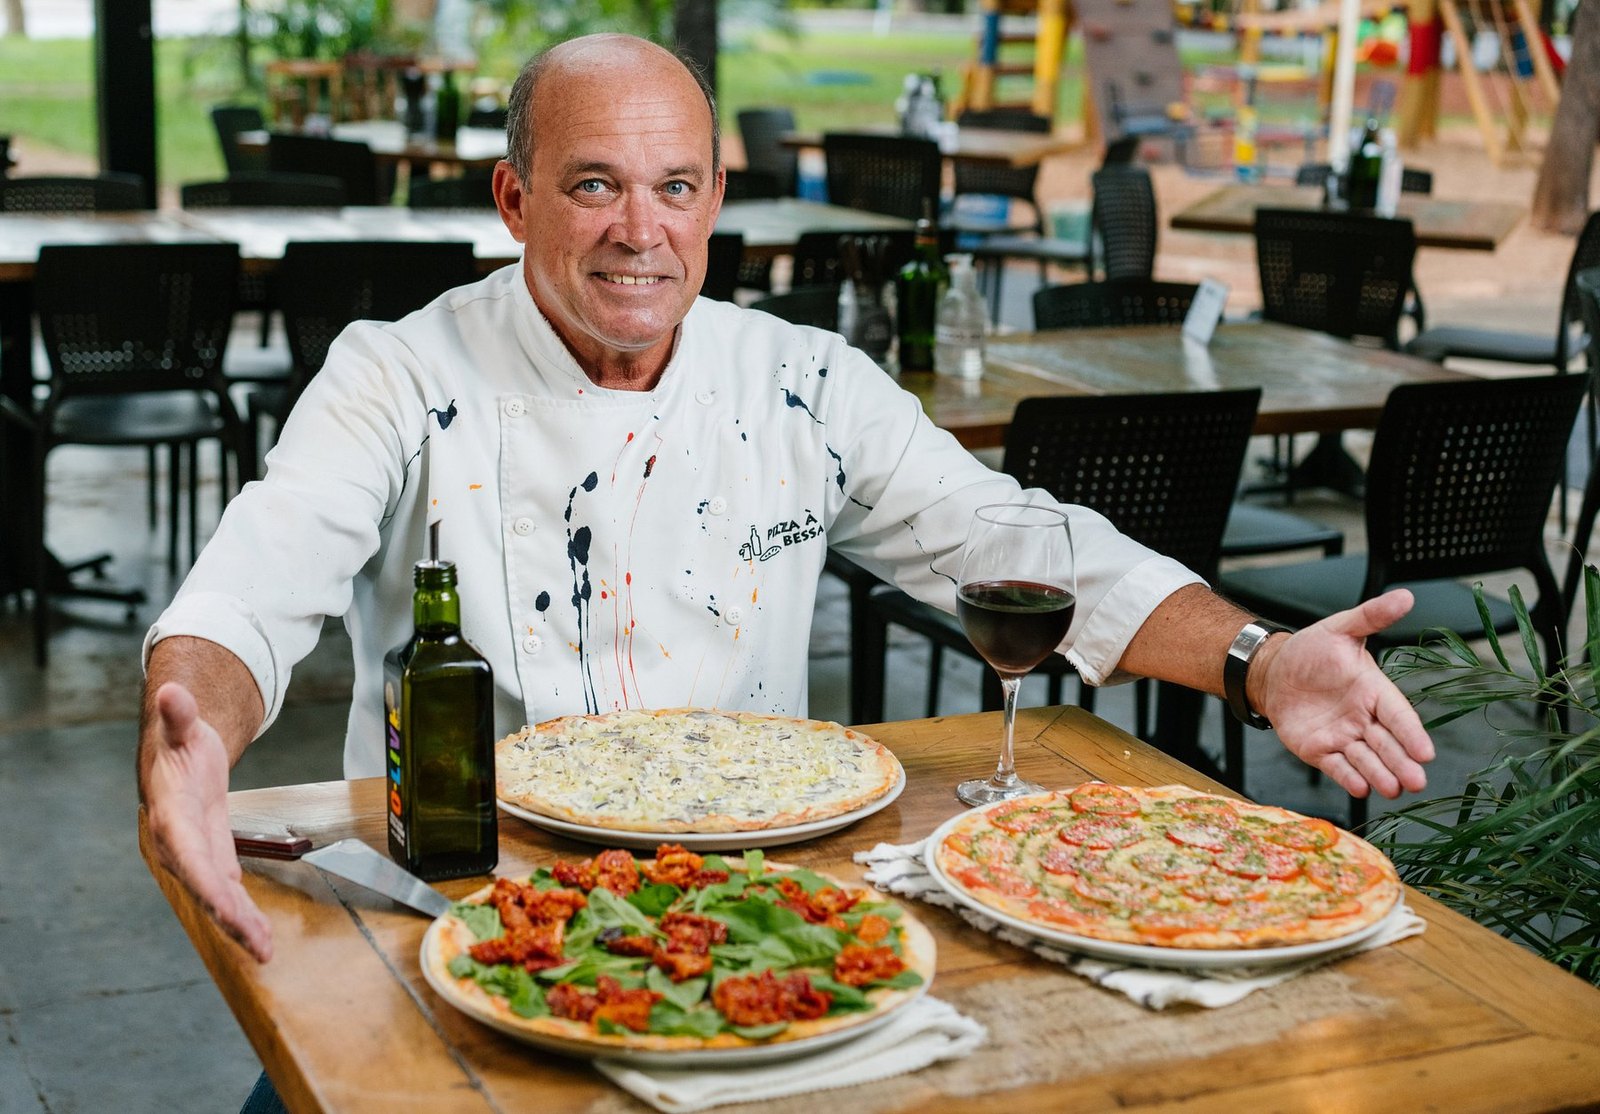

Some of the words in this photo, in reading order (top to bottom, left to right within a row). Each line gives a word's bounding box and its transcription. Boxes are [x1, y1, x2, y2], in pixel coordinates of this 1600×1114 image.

[767, 519, 800, 541] PIZZA
[805, 508, 818, 526] À
[783, 524, 824, 547] BESSA
